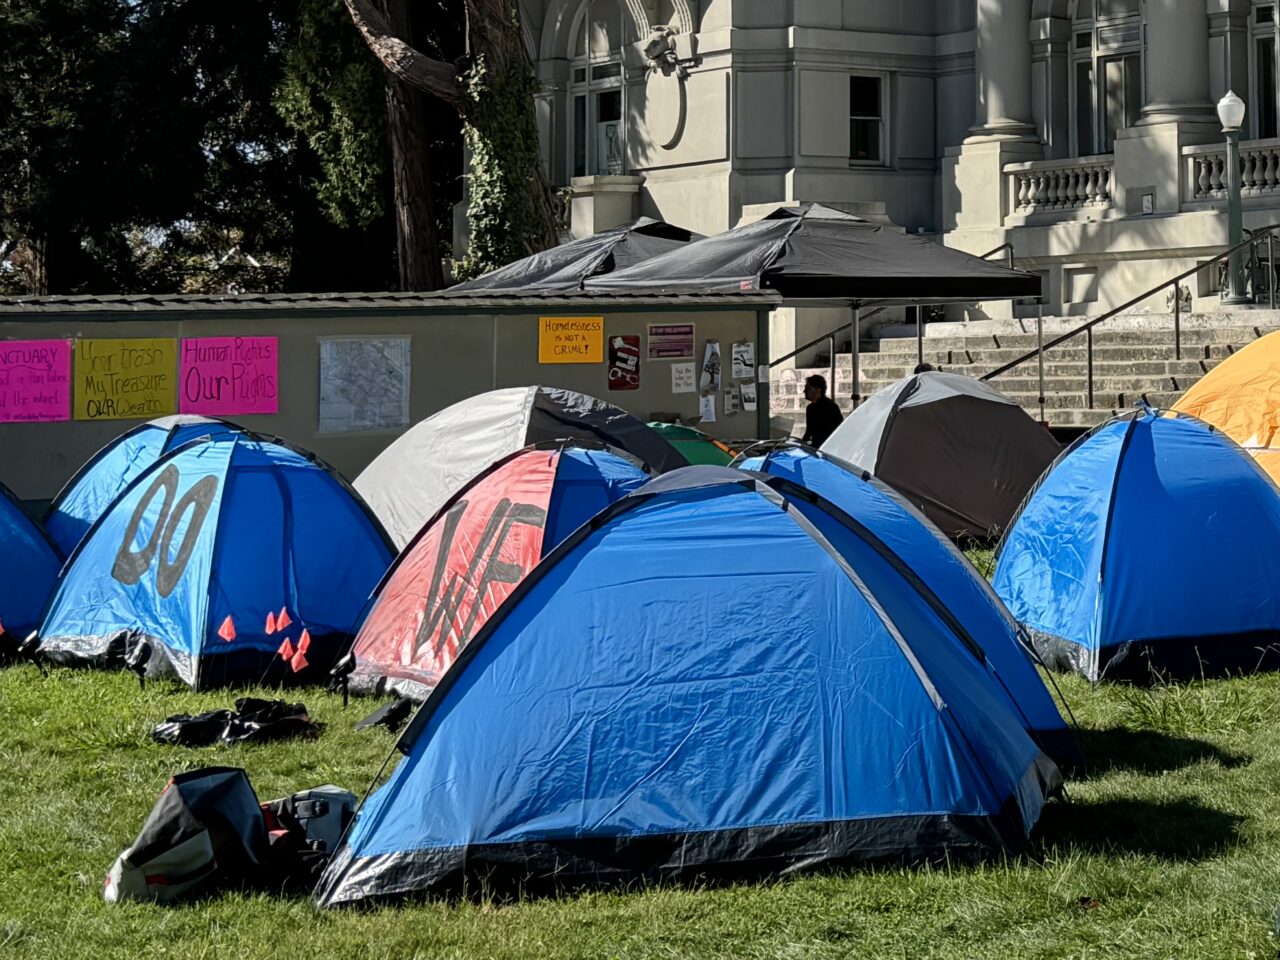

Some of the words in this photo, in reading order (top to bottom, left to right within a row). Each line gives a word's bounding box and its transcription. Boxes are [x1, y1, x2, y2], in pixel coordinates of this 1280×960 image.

[545, 319, 601, 333] Homelessness
[565, 334, 580, 342] NOT
[80, 341, 117, 374] Your
[120, 342, 163, 369] trash
[184, 339, 232, 363] Human
[234, 337, 271, 366] Rights
[554, 344, 589, 356] CRIME!
[85, 375, 108, 399] My
[104, 372, 168, 396] Treasure
[185, 366, 229, 403] Our
[232, 363, 276, 406] Rights
[87, 398, 116, 418] OUR
